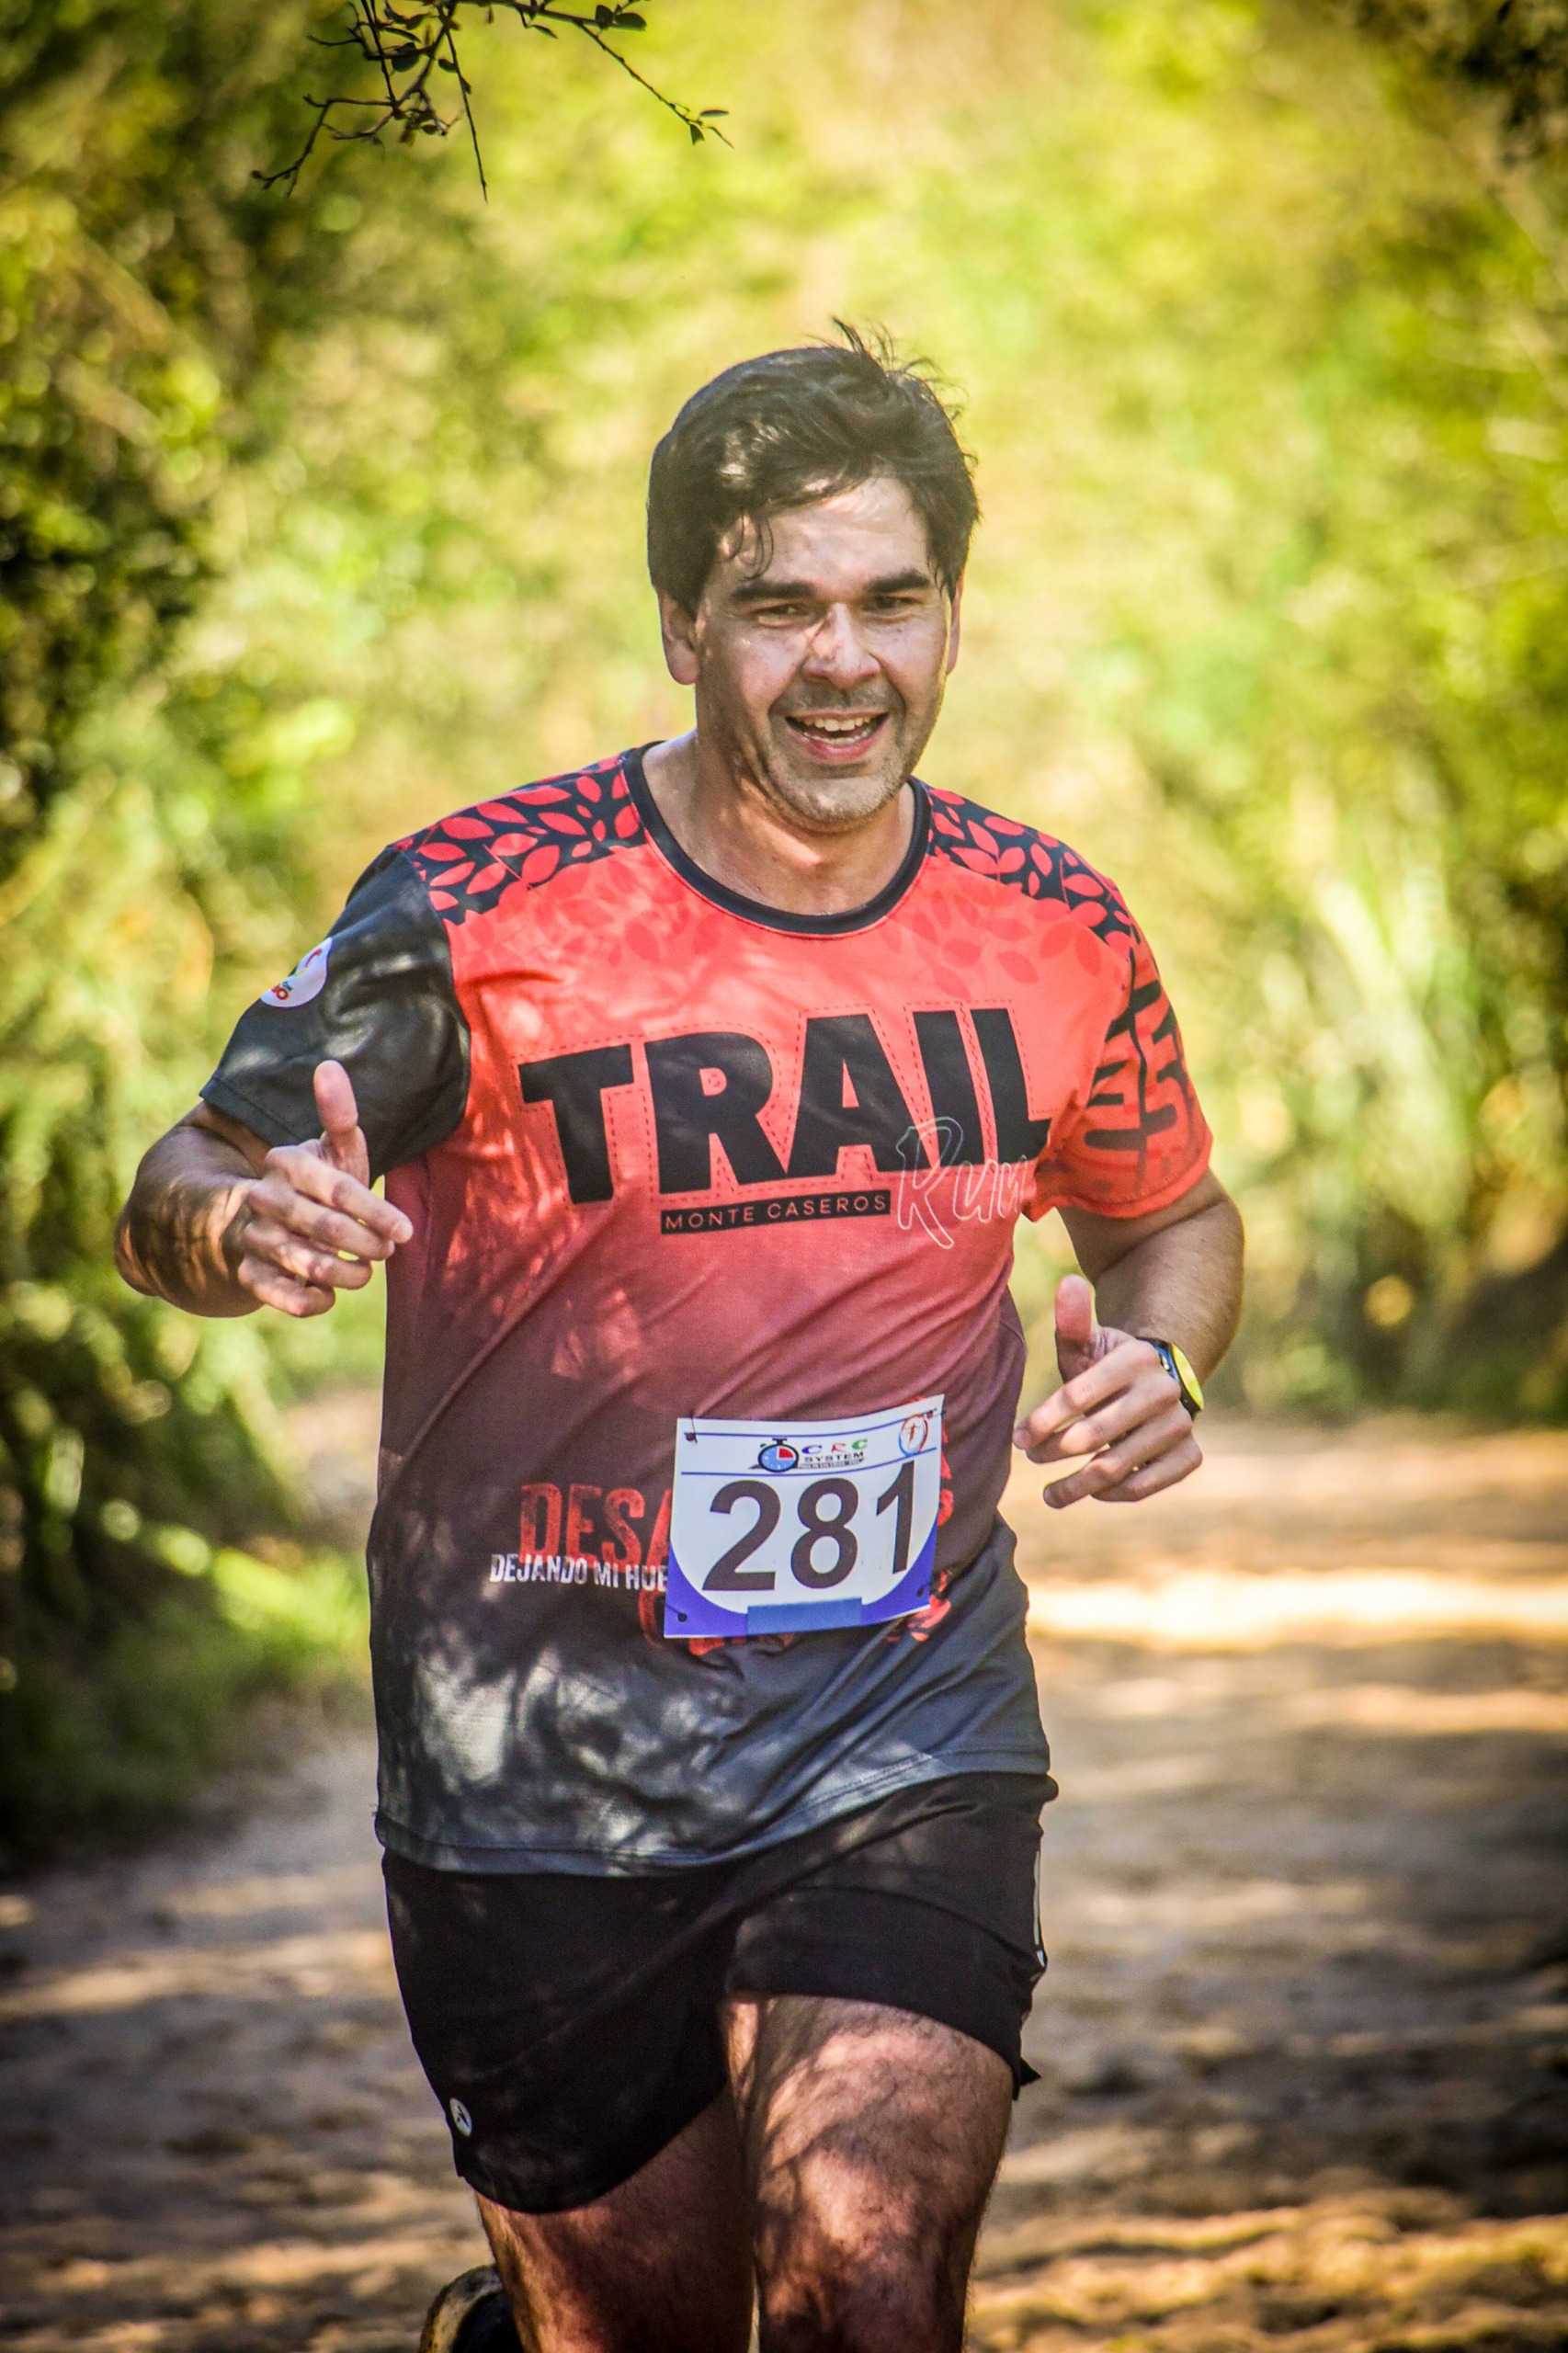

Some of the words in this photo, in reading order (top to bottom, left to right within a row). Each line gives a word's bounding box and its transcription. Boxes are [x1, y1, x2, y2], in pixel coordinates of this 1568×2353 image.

[518, 1007, 1052, 1204] TRAIL
[665, 1208, 755, 1230] MONTE
[767, 1196, 887, 1219] CASEROS
[895, 1116, 1028, 1249] Run
[804, 1451, 864, 1462] SYSTEM
[702, 1461, 915, 1591] 281
[490, 1553, 588, 1585] DEJANDO
[594, 1561, 619, 1588] MI
